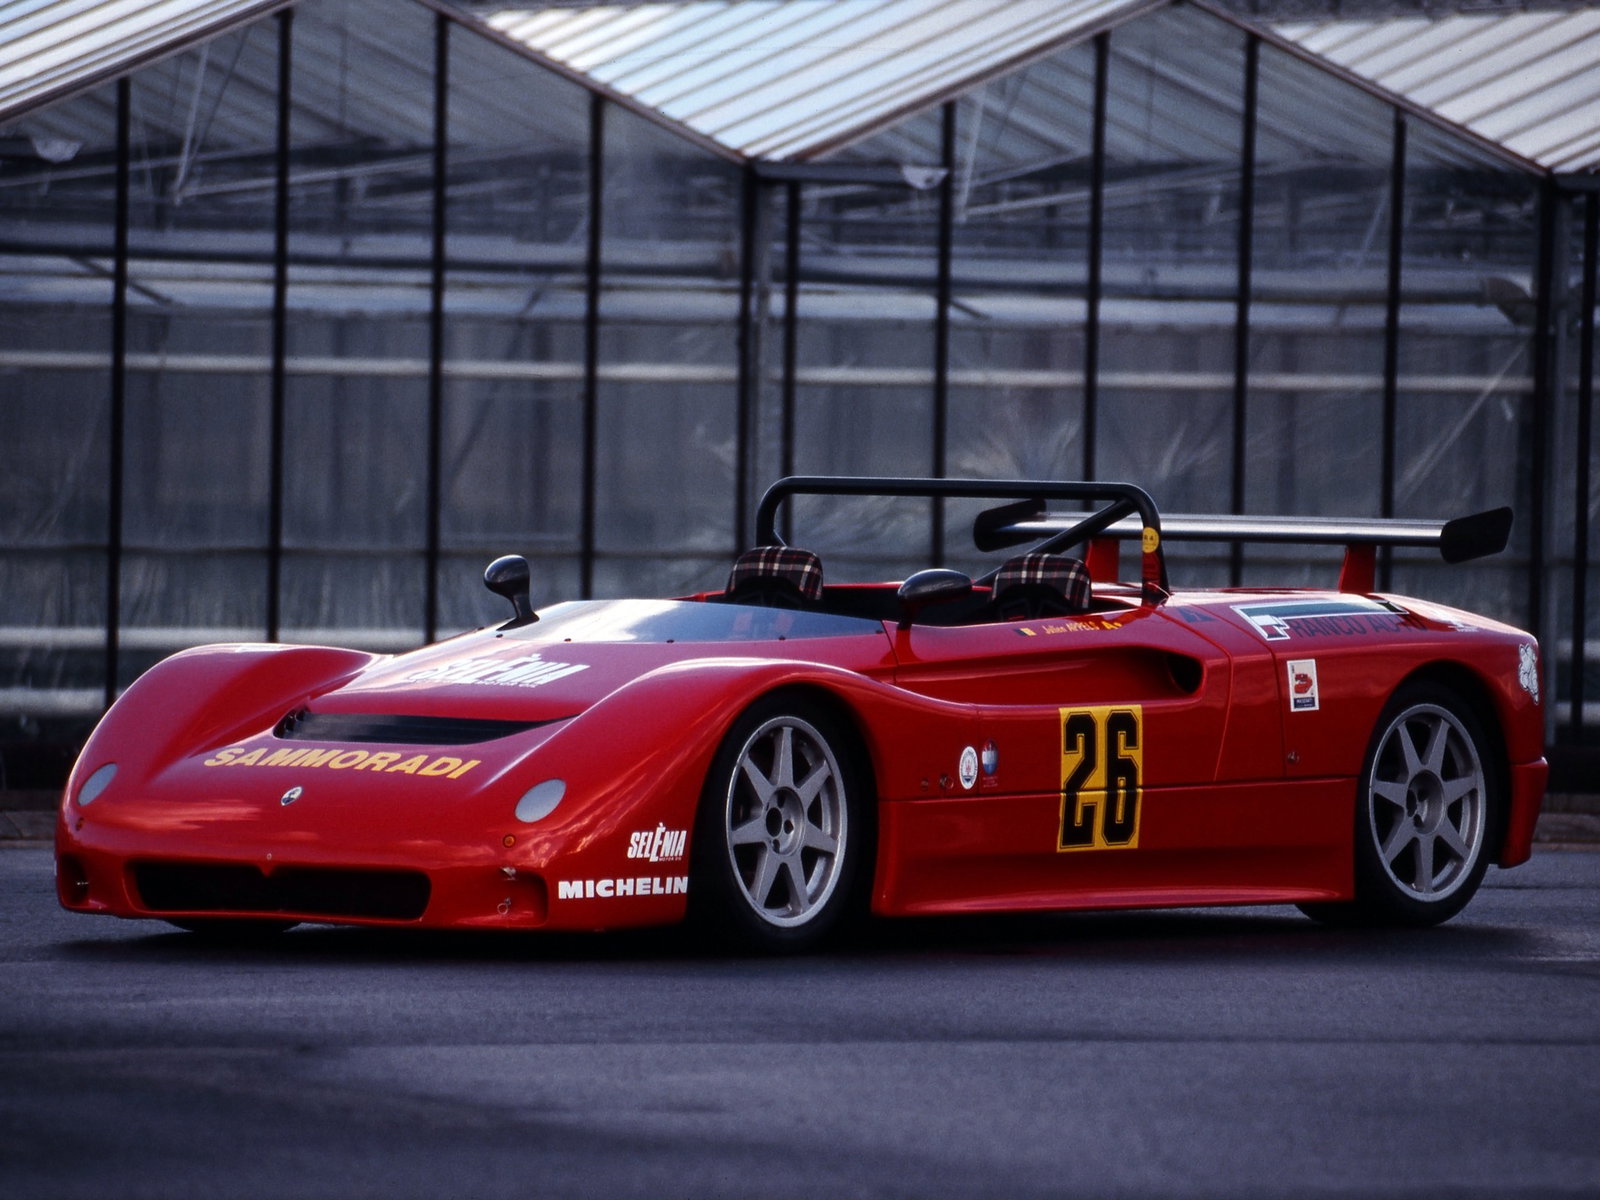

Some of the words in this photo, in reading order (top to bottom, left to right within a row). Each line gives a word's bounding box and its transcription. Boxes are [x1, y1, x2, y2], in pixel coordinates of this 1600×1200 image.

[204, 748, 480, 779] SAMMORADI
[1060, 710, 1139, 848] 26
[558, 876, 688, 899] MICHELIN
